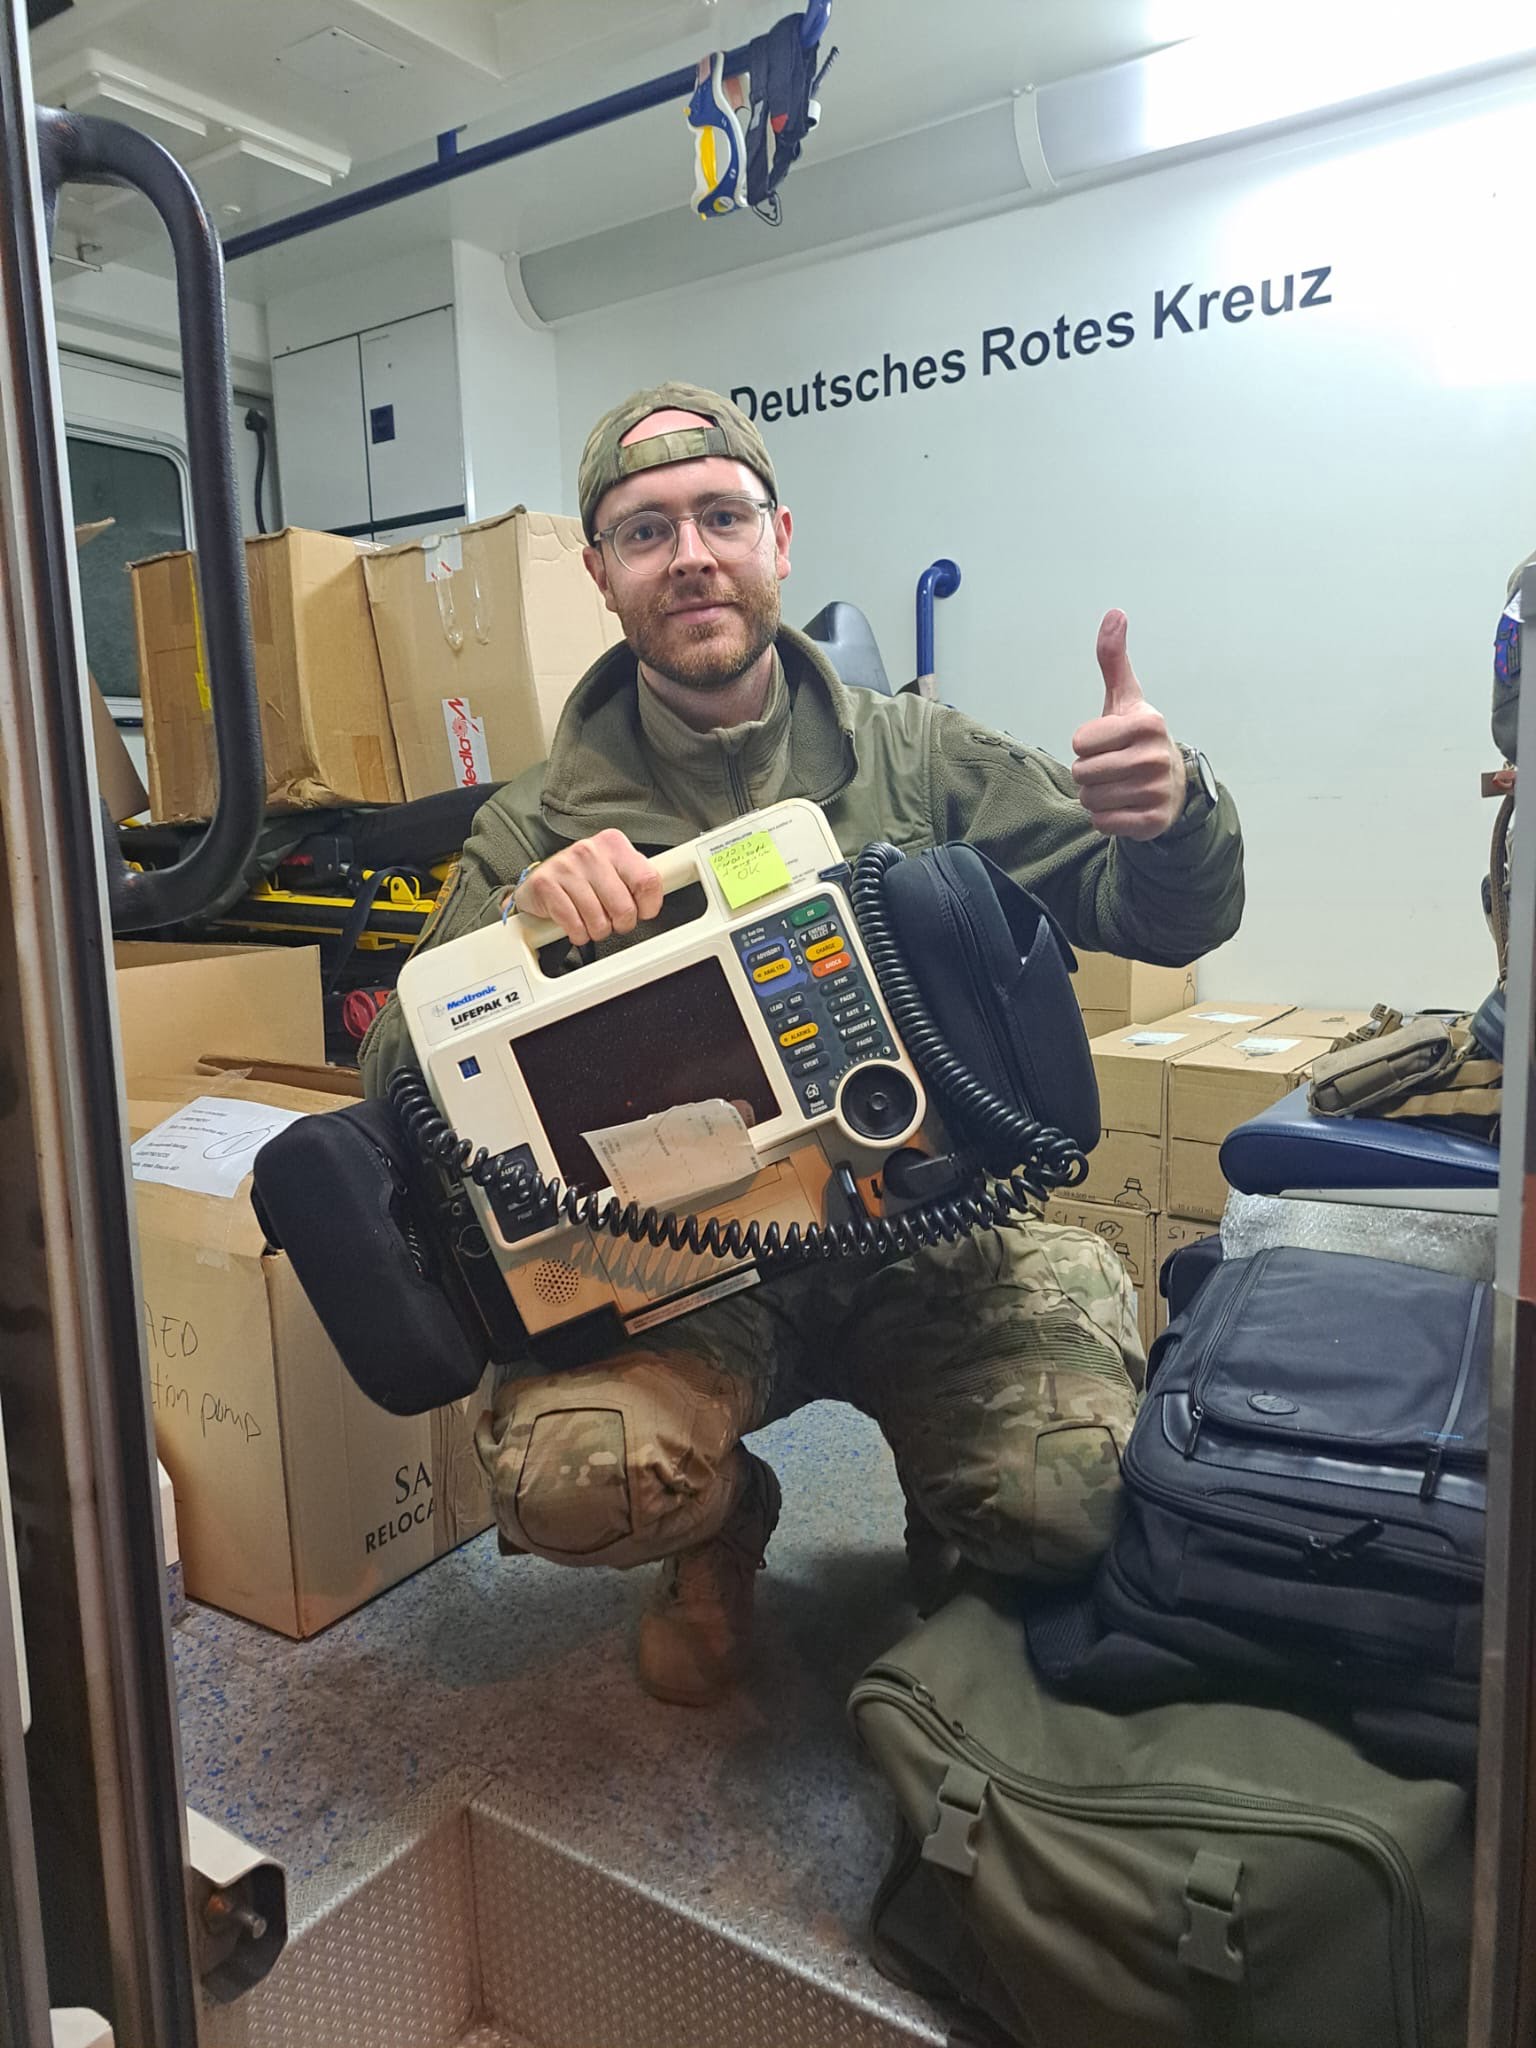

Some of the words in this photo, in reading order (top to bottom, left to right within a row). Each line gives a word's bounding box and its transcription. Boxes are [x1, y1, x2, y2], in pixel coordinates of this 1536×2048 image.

[731, 349, 966, 422] Deutsches
[982, 314, 1135, 376] Rotes
[1154, 265, 1332, 340] Kreuz
[788, 938, 797, 949] 2
[795, 954, 803, 965] 3
[446, 984, 497, 1012] Medtronic
[450, 998, 503, 1026] LIFEPAK
[504, 990, 520, 1003] 12
[769, 1001, 784, 1013] LEAD
[845, 1007, 860, 1018] RATE
